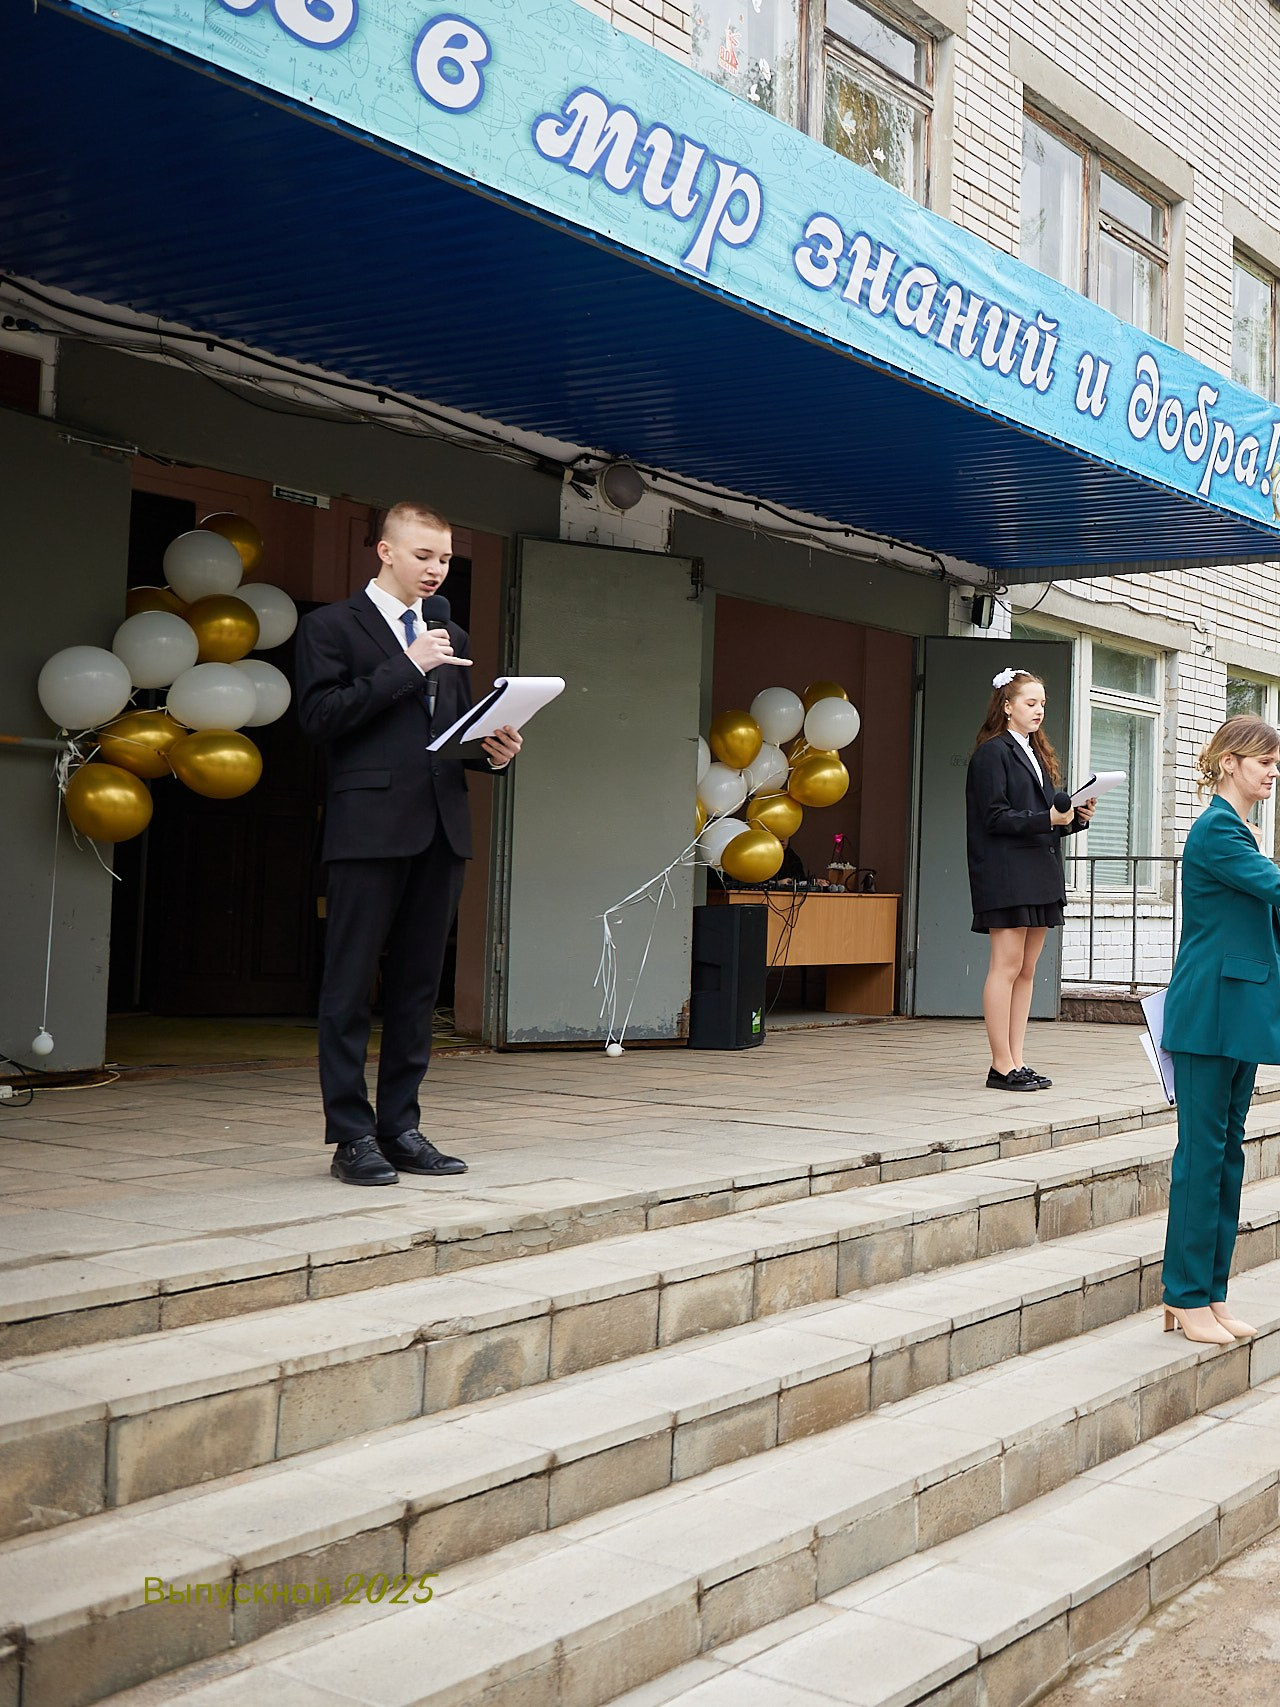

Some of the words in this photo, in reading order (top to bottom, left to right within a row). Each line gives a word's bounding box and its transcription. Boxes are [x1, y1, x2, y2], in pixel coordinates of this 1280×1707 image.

[411, 14, 492, 114] в
[532, 87, 764, 274] мир
[790, 211, 1060, 395] знаний
[1074, 351, 1111, 419] и
